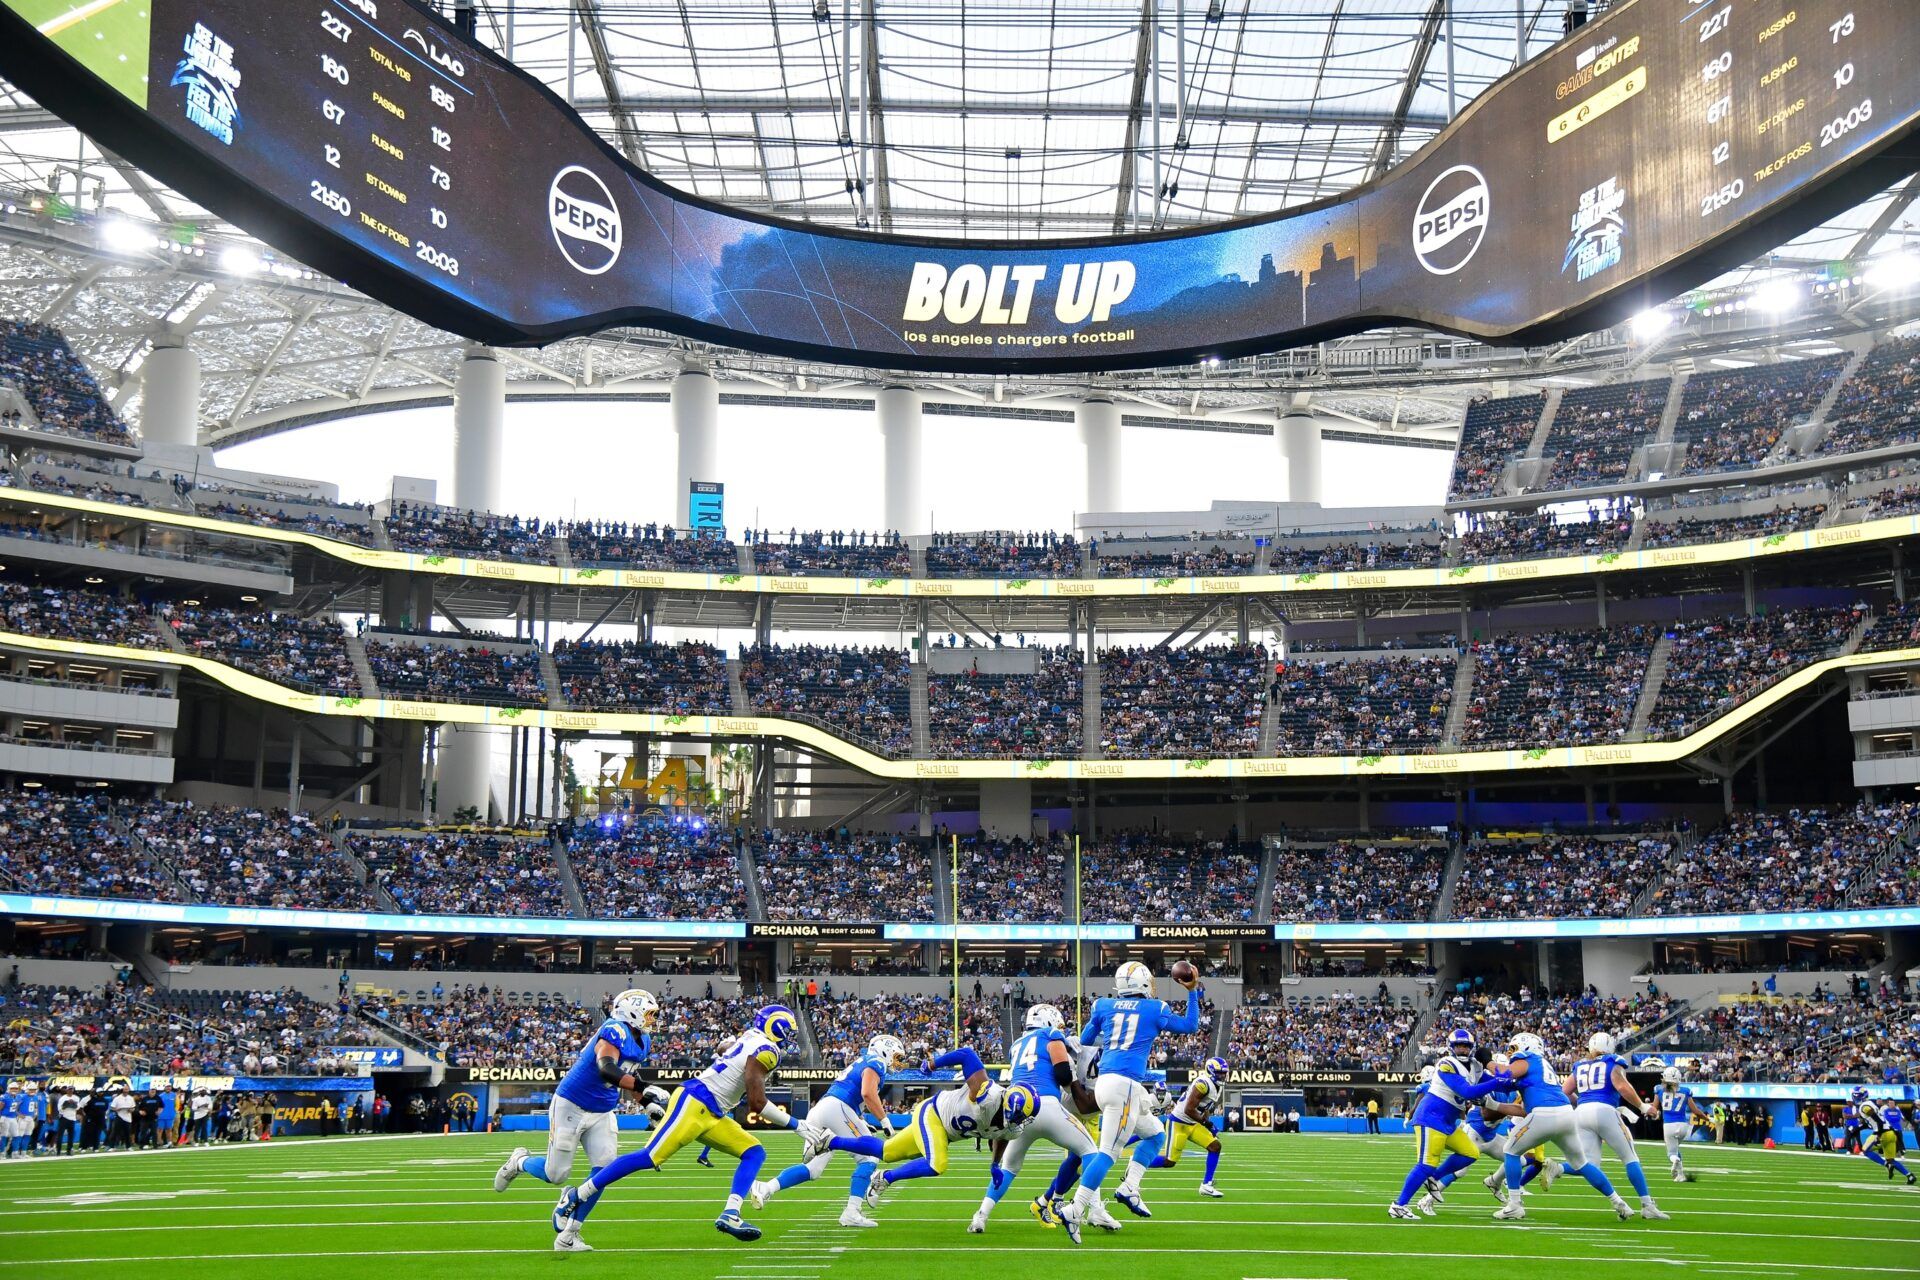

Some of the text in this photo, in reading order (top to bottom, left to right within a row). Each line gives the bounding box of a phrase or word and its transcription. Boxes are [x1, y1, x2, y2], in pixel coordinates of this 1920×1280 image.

[320, 10, 352, 43] 227
[1700, 5, 1732, 43] 227
[1759, 11, 1796, 43] PASSING
[1828, 13, 1855, 44] 73
[321, 54, 349, 85] 160
[369, 47, 412, 82] TOTAL YDS
[430, 44, 465, 77] LAC
[1556, 36, 1640, 100] GAME CENTER
[1702, 51, 1733, 83] 160
[1760, 56, 1798, 88] RUSHING
[1833, 63, 1854, 90] 10
[372, 92, 405, 120] PASSING
[429, 85, 455, 113] 185
[1707, 96, 1731, 124] 67
[323, 99, 345, 125] 67
[1757, 98, 1805, 135] 1ST DOWNS
[1820, 99, 1873, 148] 20:03
[371, 133, 404, 160] RUSHING
[431, 126, 451, 151] 112
[325, 144, 341, 169] 12
[1712, 141, 1729, 166] 12
[429, 165, 450, 190] 73
[1754, 164, 1774, 182] TIME
[1774, 155, 1787, 171] OF
[366, 173, 407, 204] 1ST DOWNS
[360, 212, 377, 230] TIME
[377, 222, 388, 234] OF
[431, 208, 447, 229] 10
[555, 196, 616, 243] PEPSI
[1419, 196, 1483, 243] PEPSI
[416, 241, 459, 276] 20:03
[903, 260, 1136, 325] BOLT UP
[904, 329, 1134, 347] los angeles chargers football
[1816, 529, 1861, 544] PACIFICO
[1653, 551, 1695, 564] PACIFICO
[476, 562, 515, 577] PACIFICO
[626, 573, 664, 586] PACIFICO
[1347, 575, 1386, 586] PACIFICO
[1499, 565, 1538, 577] PACIFICO
[770, 578, 808, 592] PACIFICO
[915, 582, 952, 594] PACIFICO
[1057, 582, 1095, 594] PACIFICO
[1202, 580, 1240, 593] PACIFICO
[392, 703, 437, 719] PACIFICO
[555, 713, 598, 728] PACIFICO
[717, 719, 759, 732] PACIFICO
[1413, 757, 1458, 769] PACIFICO
[1585, 748, 1632, 761] PACIFICO
[916, 762, 959, 776] PACIFICO
[1080, 763, 1124, 776] PACIFICO
[1244, 761, 1287, 774] PACIFICO
[620, 756, 688, 804] LA
[753, 925, 819, 936] PECHANGA
[1142, 927, 1208, 938] PECHANGA
[631, 997, 643, 1007] 73
[1113, 1000, 1139, 1011] PEREZ
[1109, 1012, 1140, 1051] 11
[1010, 1036, 1038, 1077] 74
[469, 1067, 556, 1081] PECHANGA
[658, 1069, 703, 1079] PLAY YO
[776, 1069, 841, 1079] OMBINATION
[1278, 1073, 1314, 1081] RSORT
[1316, 1073, 1351, 1081] CASINO
[1378, 1073, 1422, 1082] PLAY YO
[1576, 1061, 1607, 1093] 60
[1662, 1092, 1686, 1112] 87
[1246, 1107, 1271, 1127] 40
